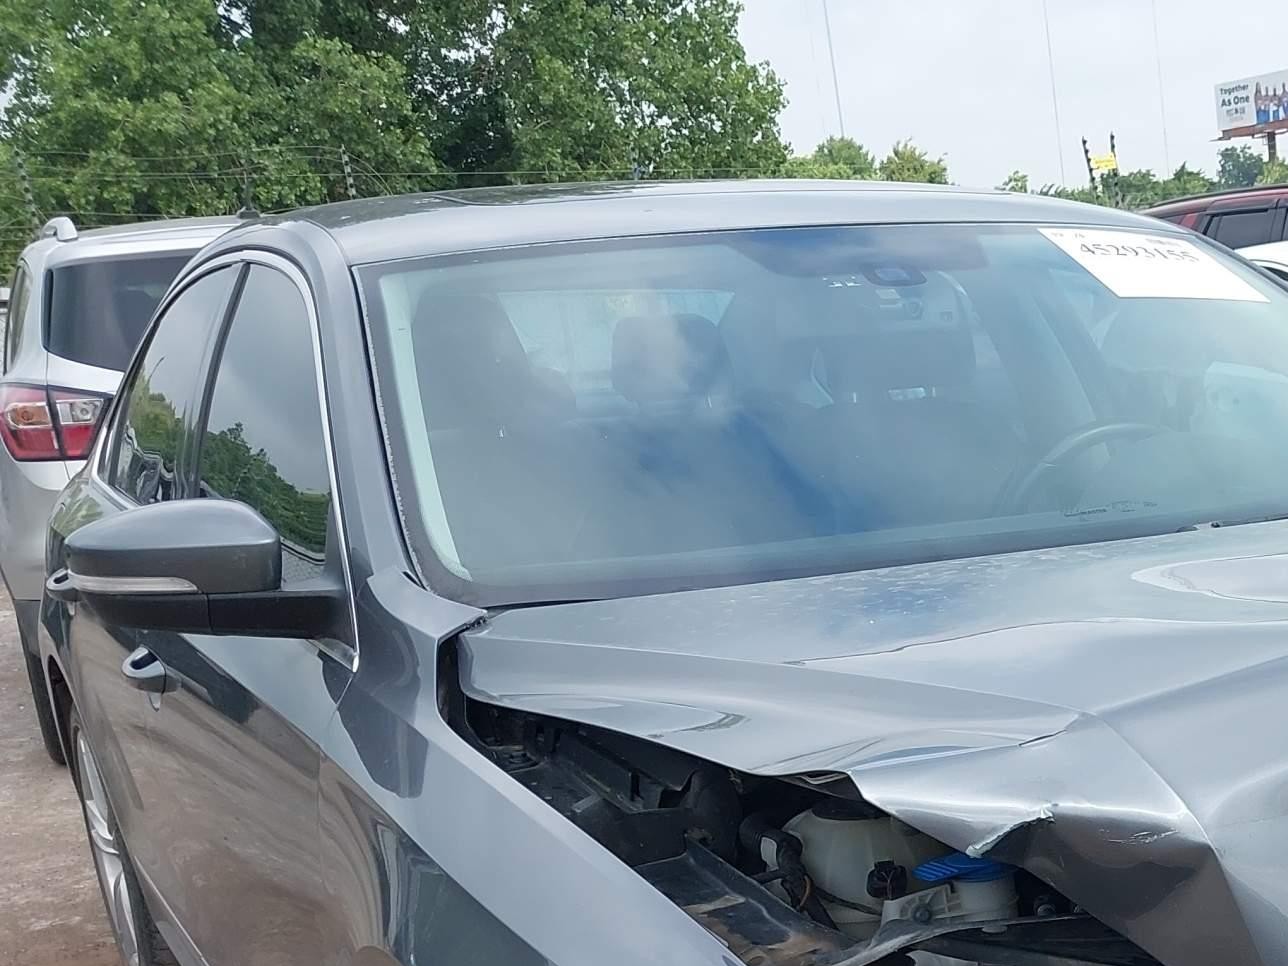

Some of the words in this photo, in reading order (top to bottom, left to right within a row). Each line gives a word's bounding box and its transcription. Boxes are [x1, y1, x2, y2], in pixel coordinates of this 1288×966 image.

[1220, 84, 1249, 96] Together
[1221, 98, 1232, 107] As
[1233, 96, 1250, 105] One
